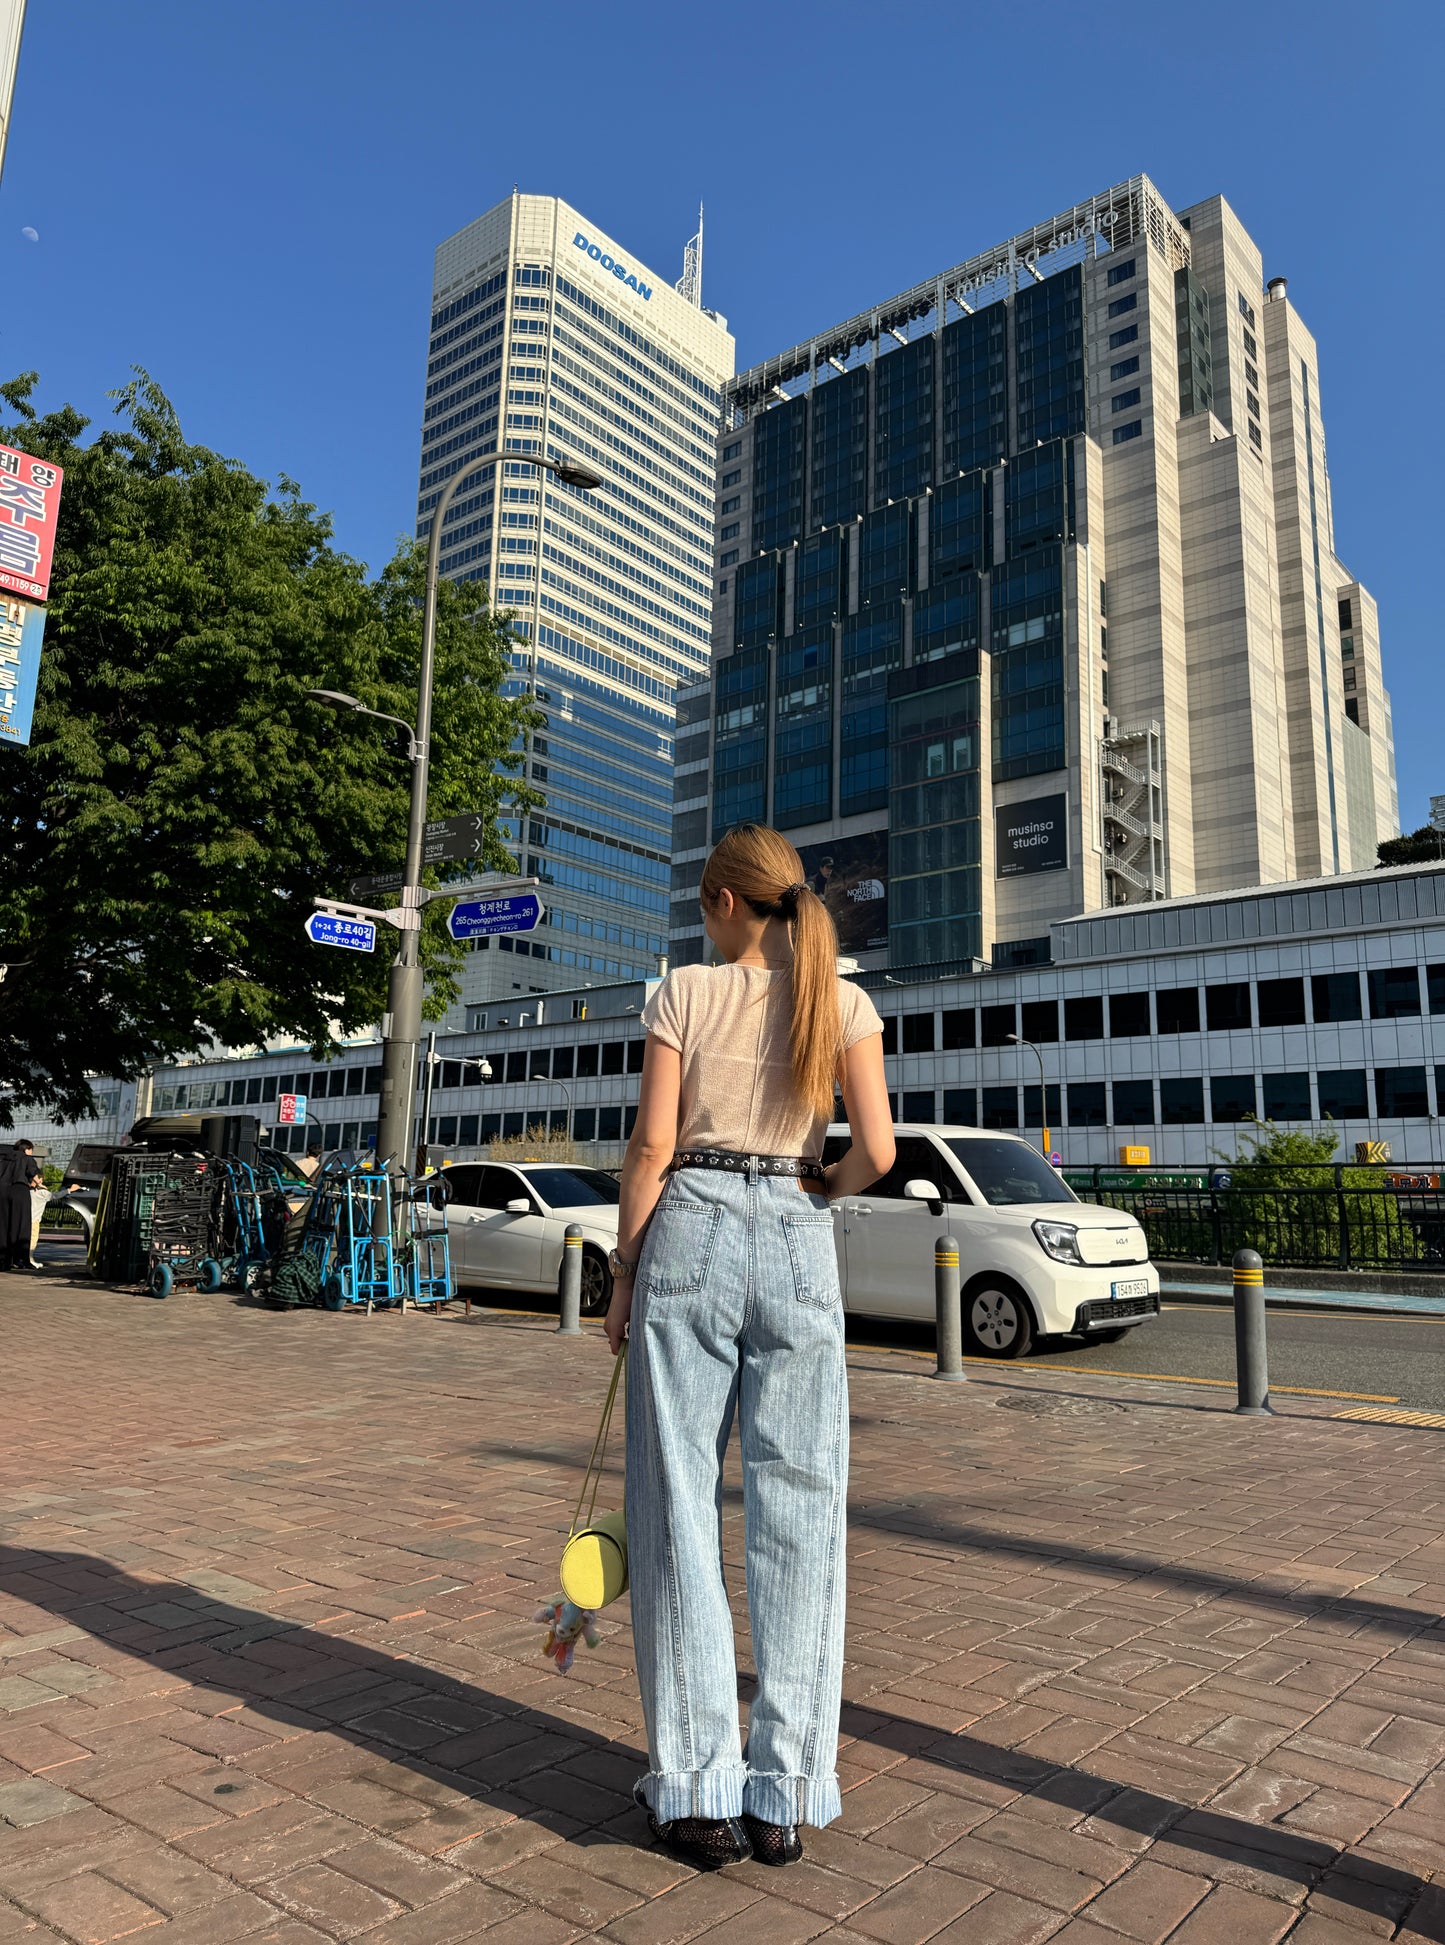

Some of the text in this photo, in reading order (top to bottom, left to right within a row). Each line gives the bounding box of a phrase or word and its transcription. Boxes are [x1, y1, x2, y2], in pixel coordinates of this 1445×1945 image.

[956, 209, 1119, 297] musinsa studio
[572, 231, 653, 301] DOOSAN
[0, 476, 46, 577] 주름
[1008, 821, 1054, 837] musinsa
[1013, 833, 1049, 849] studio
[847, 886, 872, 898] NORTH
[857, 880, 872, 889] THE
[853, 893, 872, 903] FACE
[479, 900, 511, 915] 청계천로
[455, 907, 534, 925] 265 Cheonggyecheon-ro 261
[334, 921, 372, 940] 종로40길
[320, 932, 372, 949] Jong-ro 40-gil
